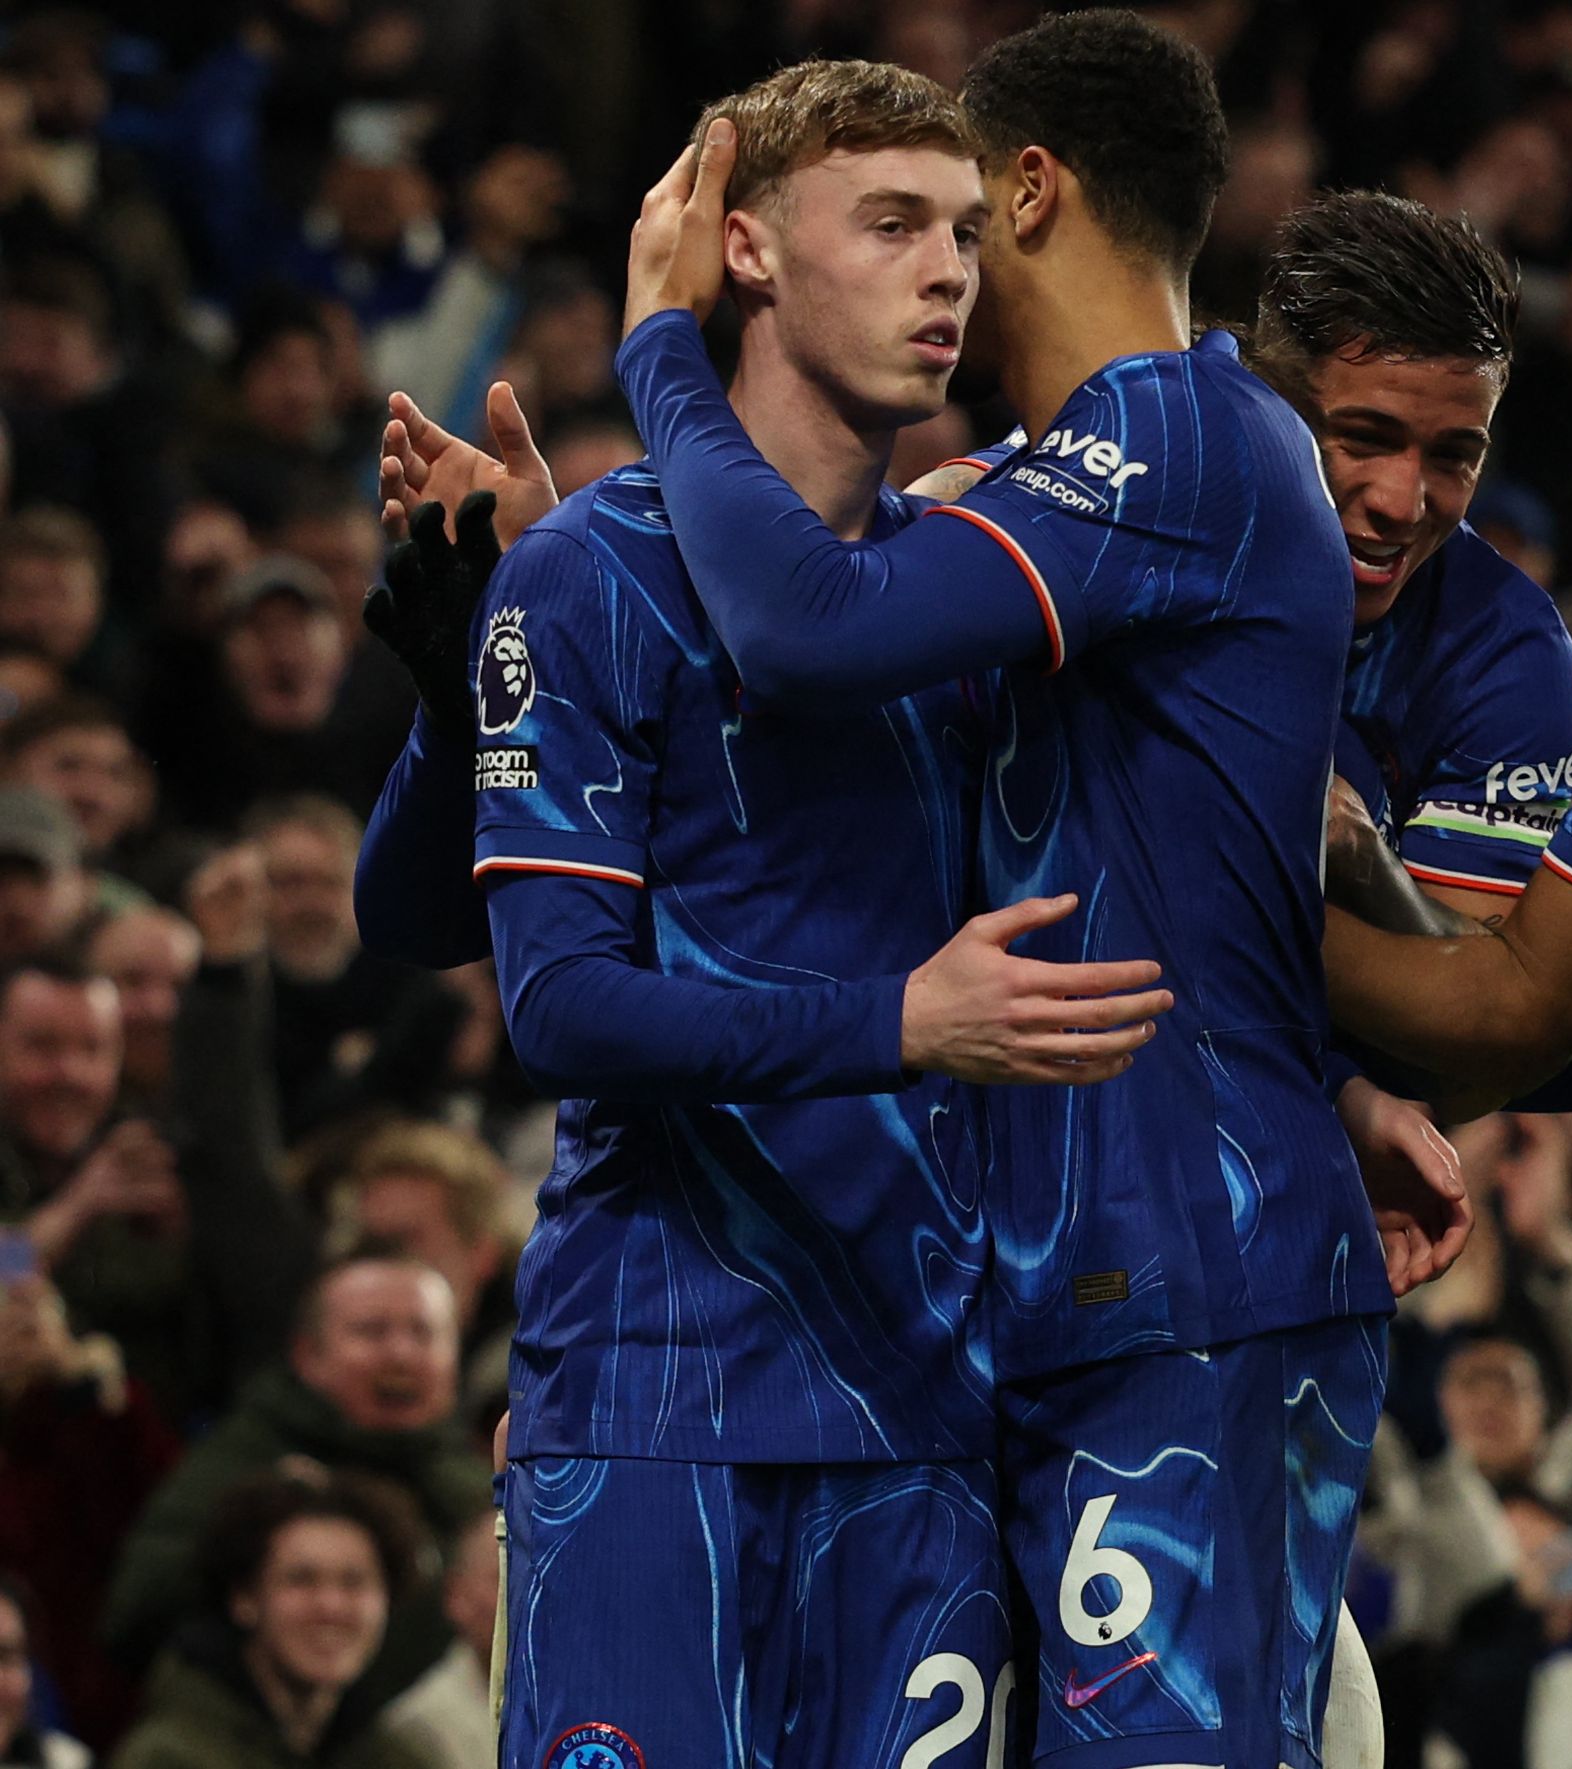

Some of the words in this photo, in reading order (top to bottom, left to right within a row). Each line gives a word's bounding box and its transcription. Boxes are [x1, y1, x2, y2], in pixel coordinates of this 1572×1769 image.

[1035, 429, 1148, 489] ever
[1011, 466, 1097, 513] erup.com
[483, 749, 528, 770] room
[1059, 1494, 1153, 1646] 6
[561, 1729, 626, 1752] CHELSEA
